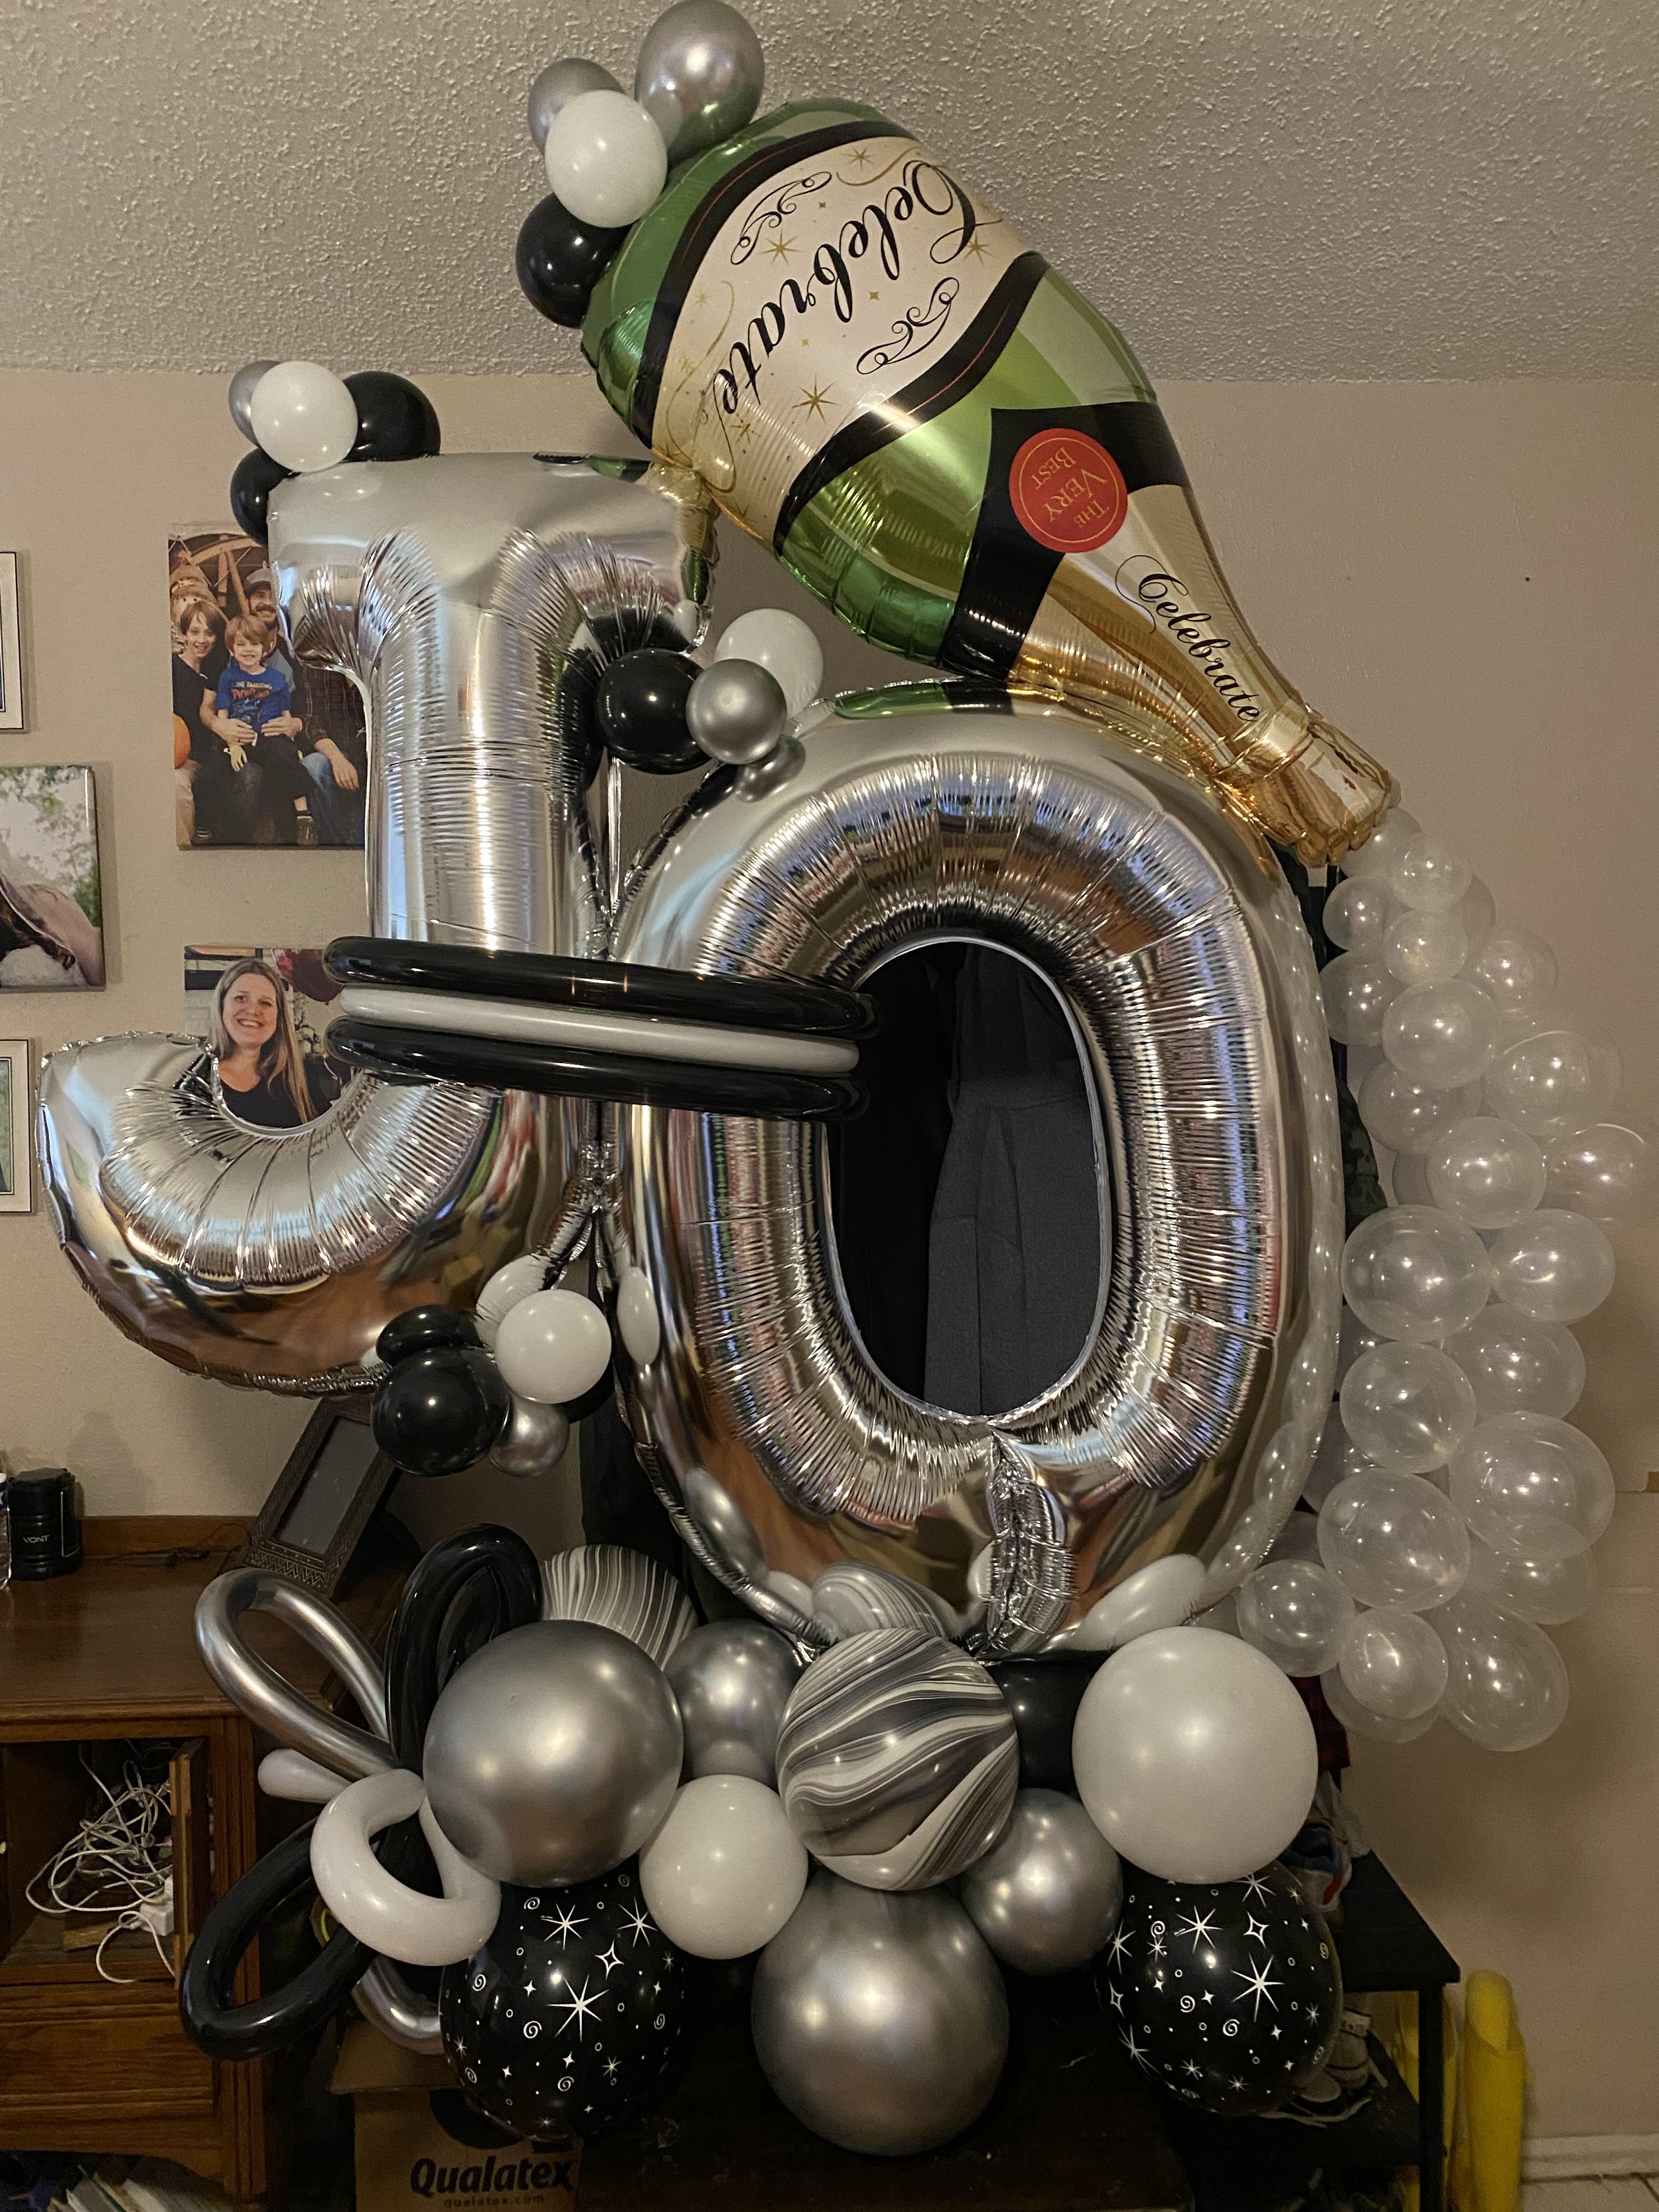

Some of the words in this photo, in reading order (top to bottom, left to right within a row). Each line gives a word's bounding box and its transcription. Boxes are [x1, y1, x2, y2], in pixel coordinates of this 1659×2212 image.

[713, 159, 1003, 492] Celebrate
[1031, 447, 1076, 490] BEST
[1043, 469, 1109, 523] VERY
[1073, 498, 1110, 528] THE
[1115, 554, 1260, 722] Celebrate
[23, 1534, 49, 1544] VONT
[410, 2155, 575, 2198] Qualatex
